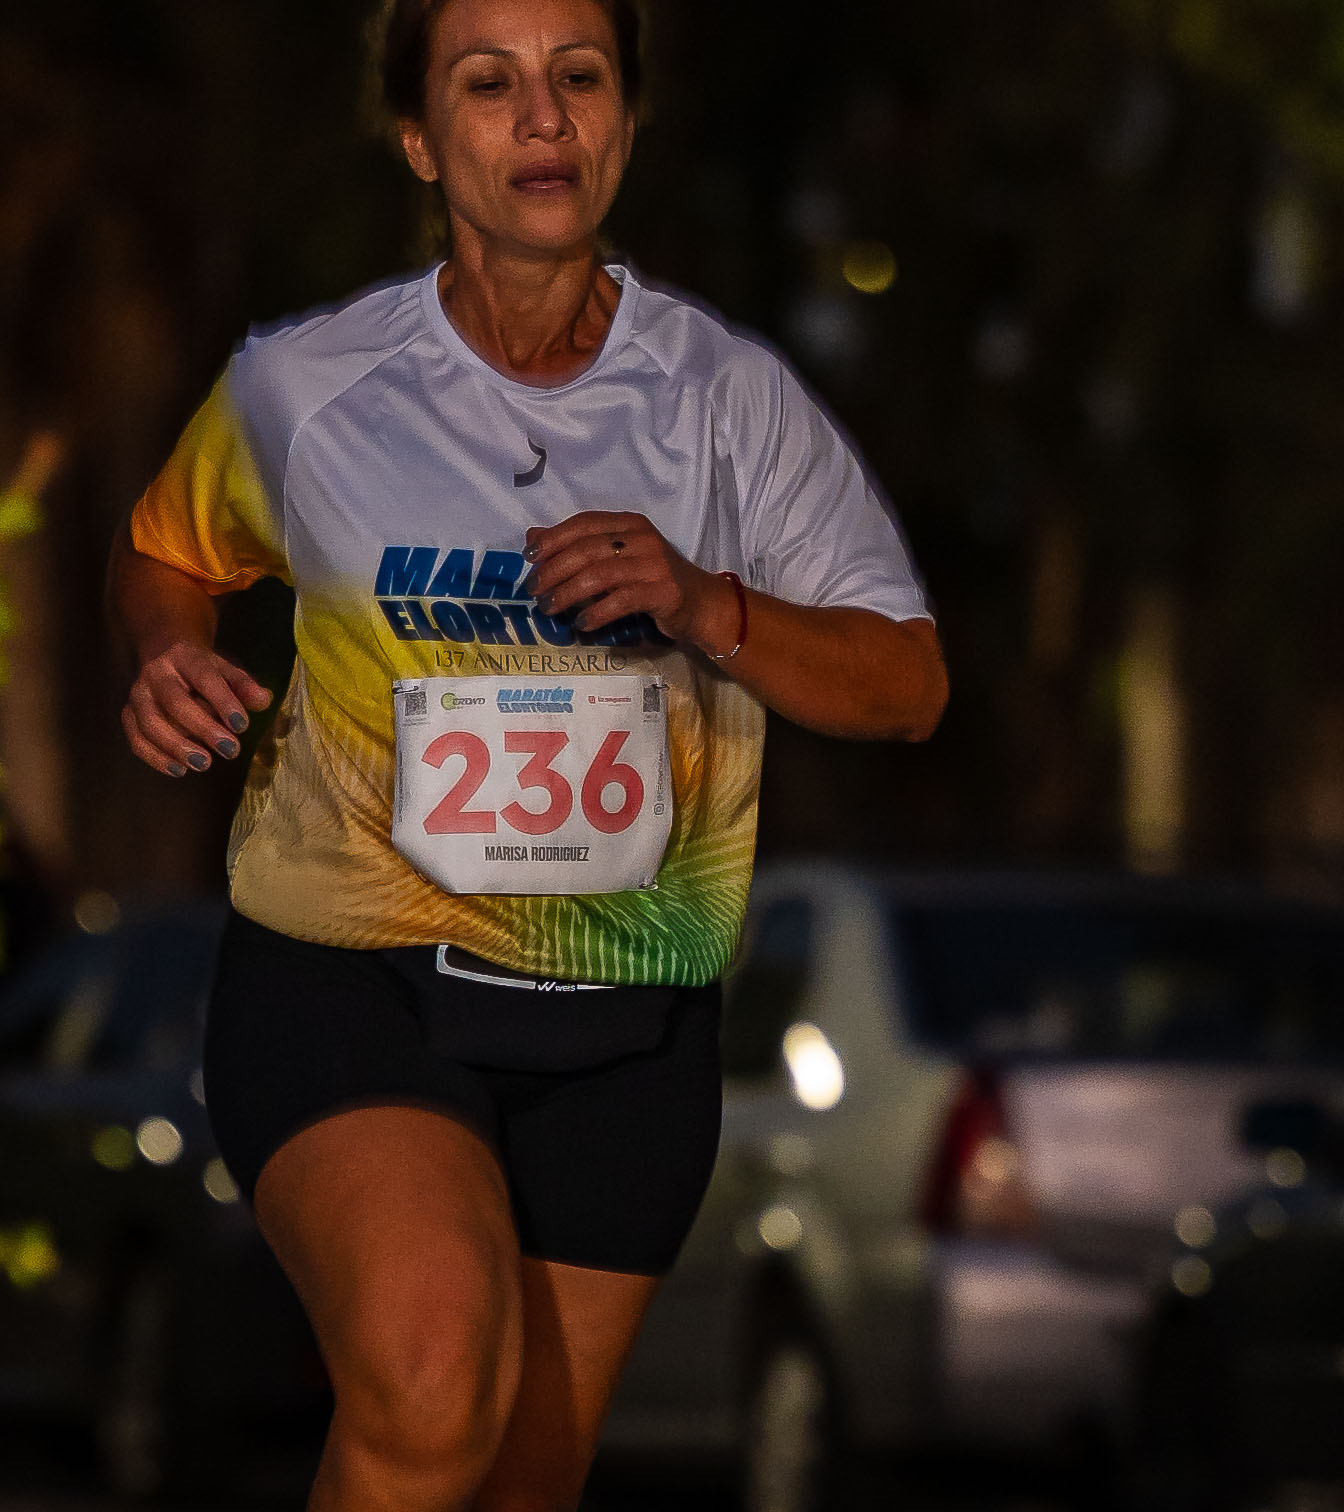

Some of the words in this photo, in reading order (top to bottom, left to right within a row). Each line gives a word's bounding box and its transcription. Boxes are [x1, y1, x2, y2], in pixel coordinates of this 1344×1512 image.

[377, 599, 675, 647] ELORTO
[435, 650, 464, 667] 137
[473, 651, 627, 673] ANIVERSARIO
[421, 730, 645, 836] 236
[484, 846, 529, 862] MARISA
[530, 846, 590, 862] RODRIGUEZ
